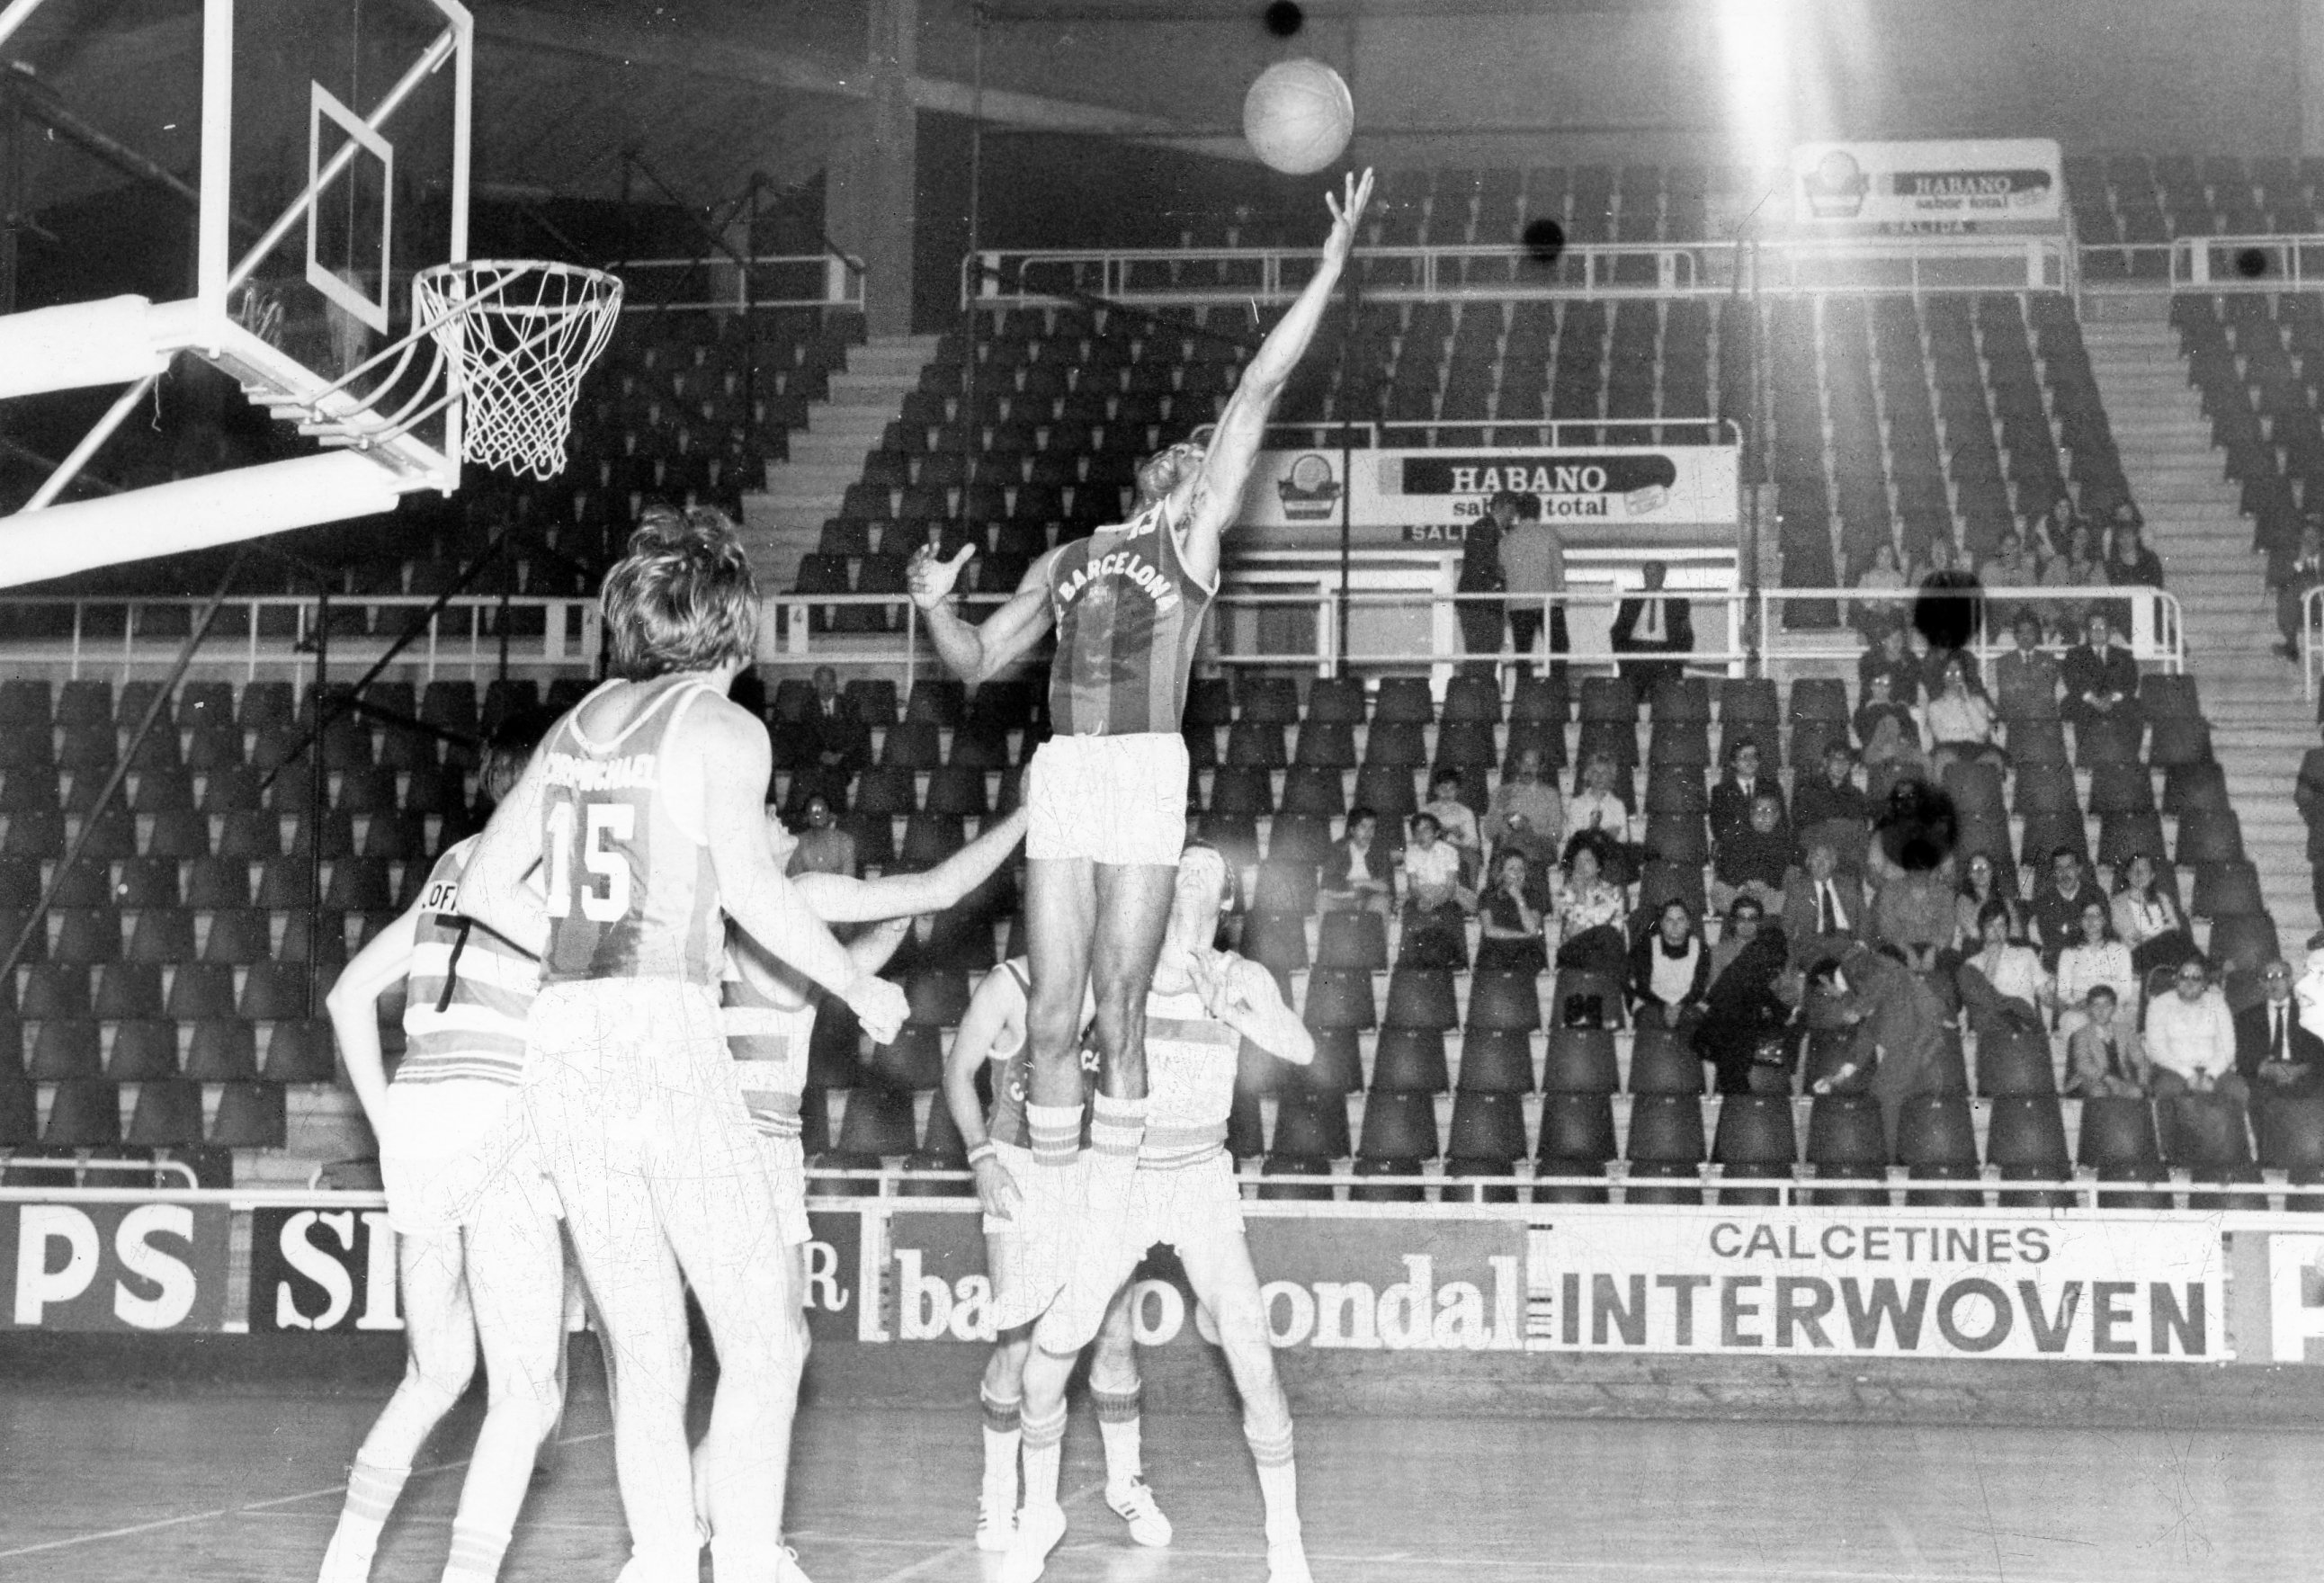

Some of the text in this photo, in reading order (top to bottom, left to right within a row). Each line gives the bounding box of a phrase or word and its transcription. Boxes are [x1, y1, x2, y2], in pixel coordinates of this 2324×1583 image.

[1916, 176, 2011, 194] HABANO
[1451, 466, 1608, 493] HABANO
[1546, 496, 1608, 516] total
[1411, 525, 1468, 540] SALI
[1059, 551, 1180, 612] BARCELONA
[545, 801, 636, 923] 15
[14, 1204, 196, 1329] PS
[276, 1210, 405, 1330] SI
[1710, 1222, 2051, 1263] CALCETINES
[1195, 1254, 1525, 1350] ondal
[1562, 1272, 2207, 1355] INTERWOVEN
